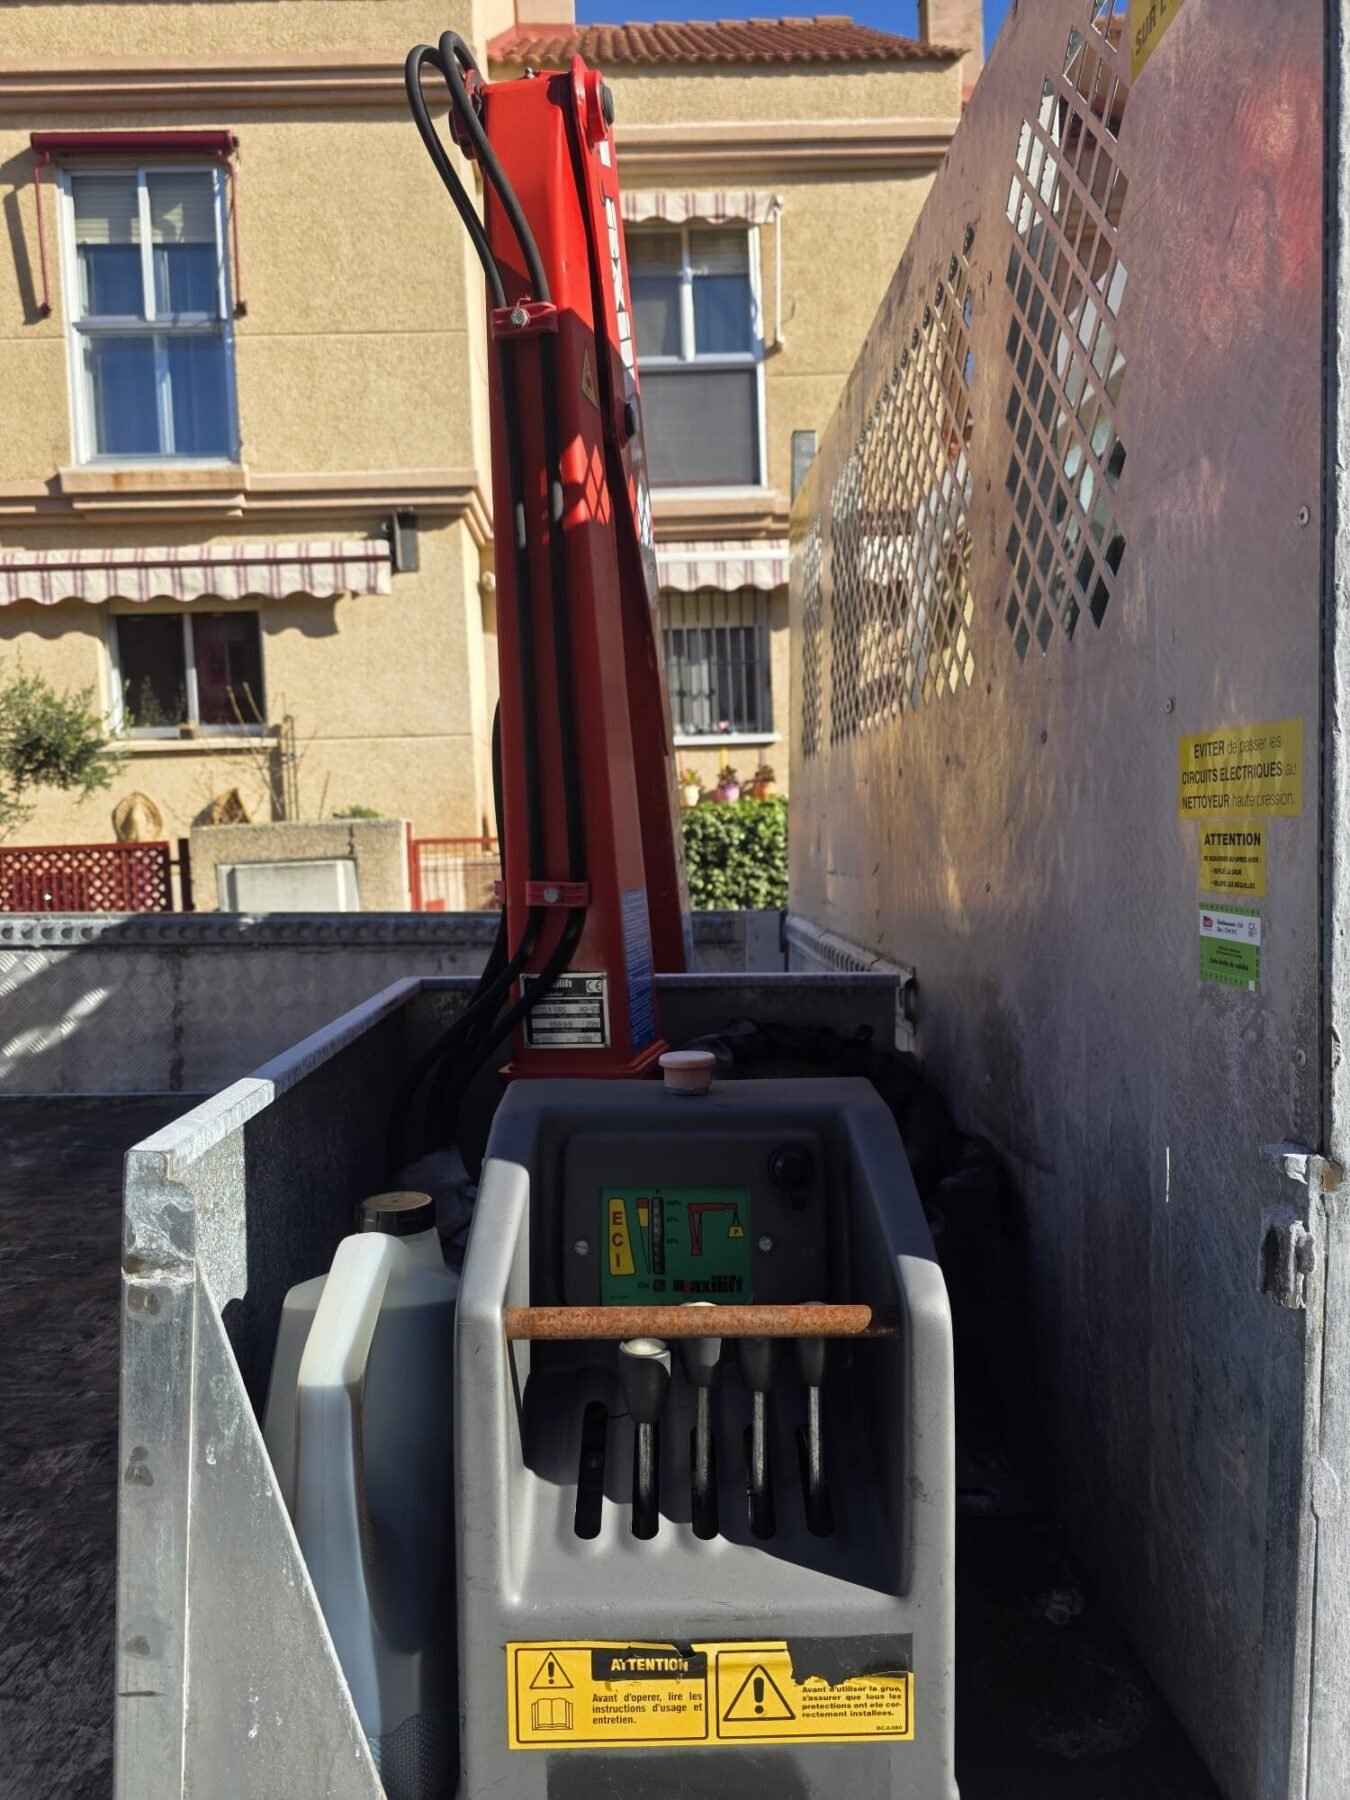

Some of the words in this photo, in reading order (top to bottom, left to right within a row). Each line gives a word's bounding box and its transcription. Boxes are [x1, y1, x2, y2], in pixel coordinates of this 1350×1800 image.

[1135, 4, 1157, 56] SUR
[1194, 740, 1225, 759] EVITER
[1227, 739, 1237, 754] de
[1239, 737, 1268, 756] passer
[1269, 736, 1282, 749] les
[1182, 768, 1218, 785] CIRCUITS
[1220, 760, 1283, 782] ELECTRIQUES
[1285, 762, 1297, 776] au
[1182, 793, 1230, 810] NETTOYEUR
[1232, 792, 1256, 808] haute
[1204, 832, 1261, 846] ATTENTION
[610, 1658, 688, 1672] ATTENTION
[592, 1693, 618, 1702] Avant
[624, 1692, 662, 1704] d'operer,
[668, 1692, 683, 1701] lire
[689, 1692, 702, 1700] les
[592, 1704, 646, 1714] instructions
[652, 1704, 688, 1714] d'usage
[694, 1703, 702, 1712] et
[802, 1702, 852, 1710] protections
[592, 1716, 636, 1725] entretien.
[802, 1710, 848, 1718] rectement
